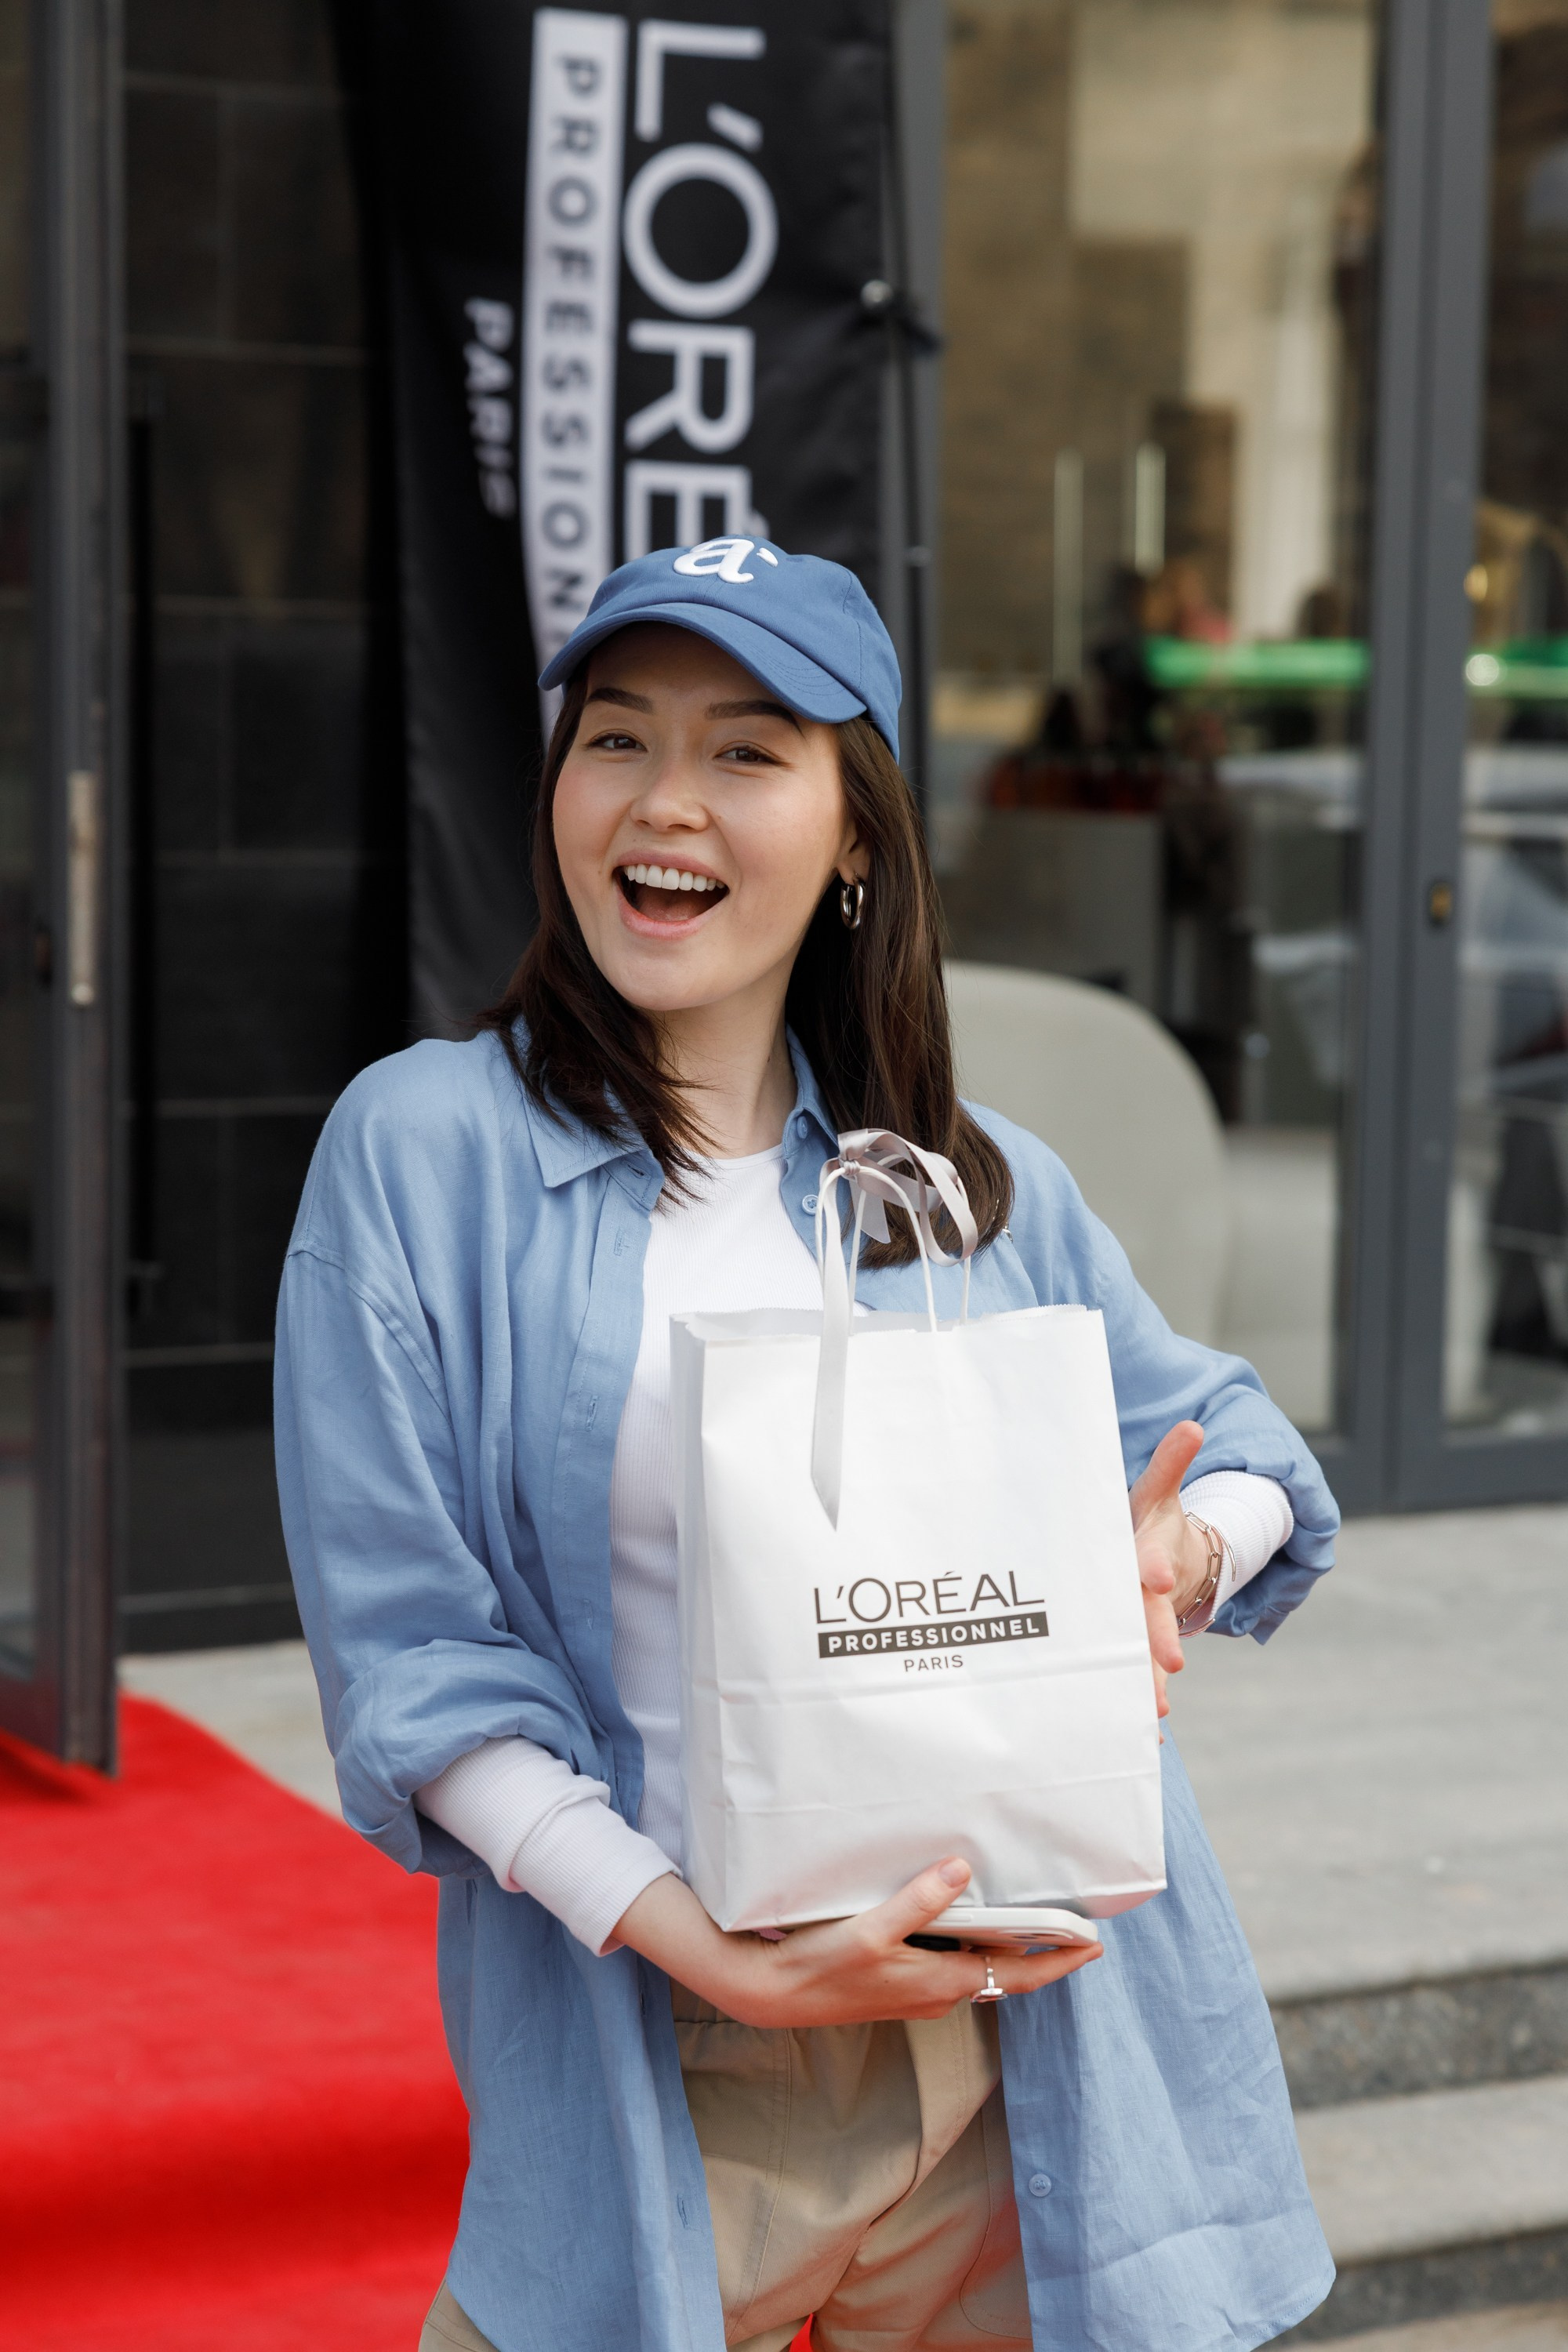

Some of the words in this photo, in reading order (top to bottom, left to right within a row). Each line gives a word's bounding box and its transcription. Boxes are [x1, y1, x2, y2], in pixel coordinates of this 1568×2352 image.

[624, 20, 779, 560] L'ORÉ
[542, 55, 599, 644] PROFESSION
[814, 1570, 1045, 1624] L'ORÉAL
[828, 1617, 1040, 1653] PROFESSIONNEL
[903, 1654, 964, 1672] PARIS
